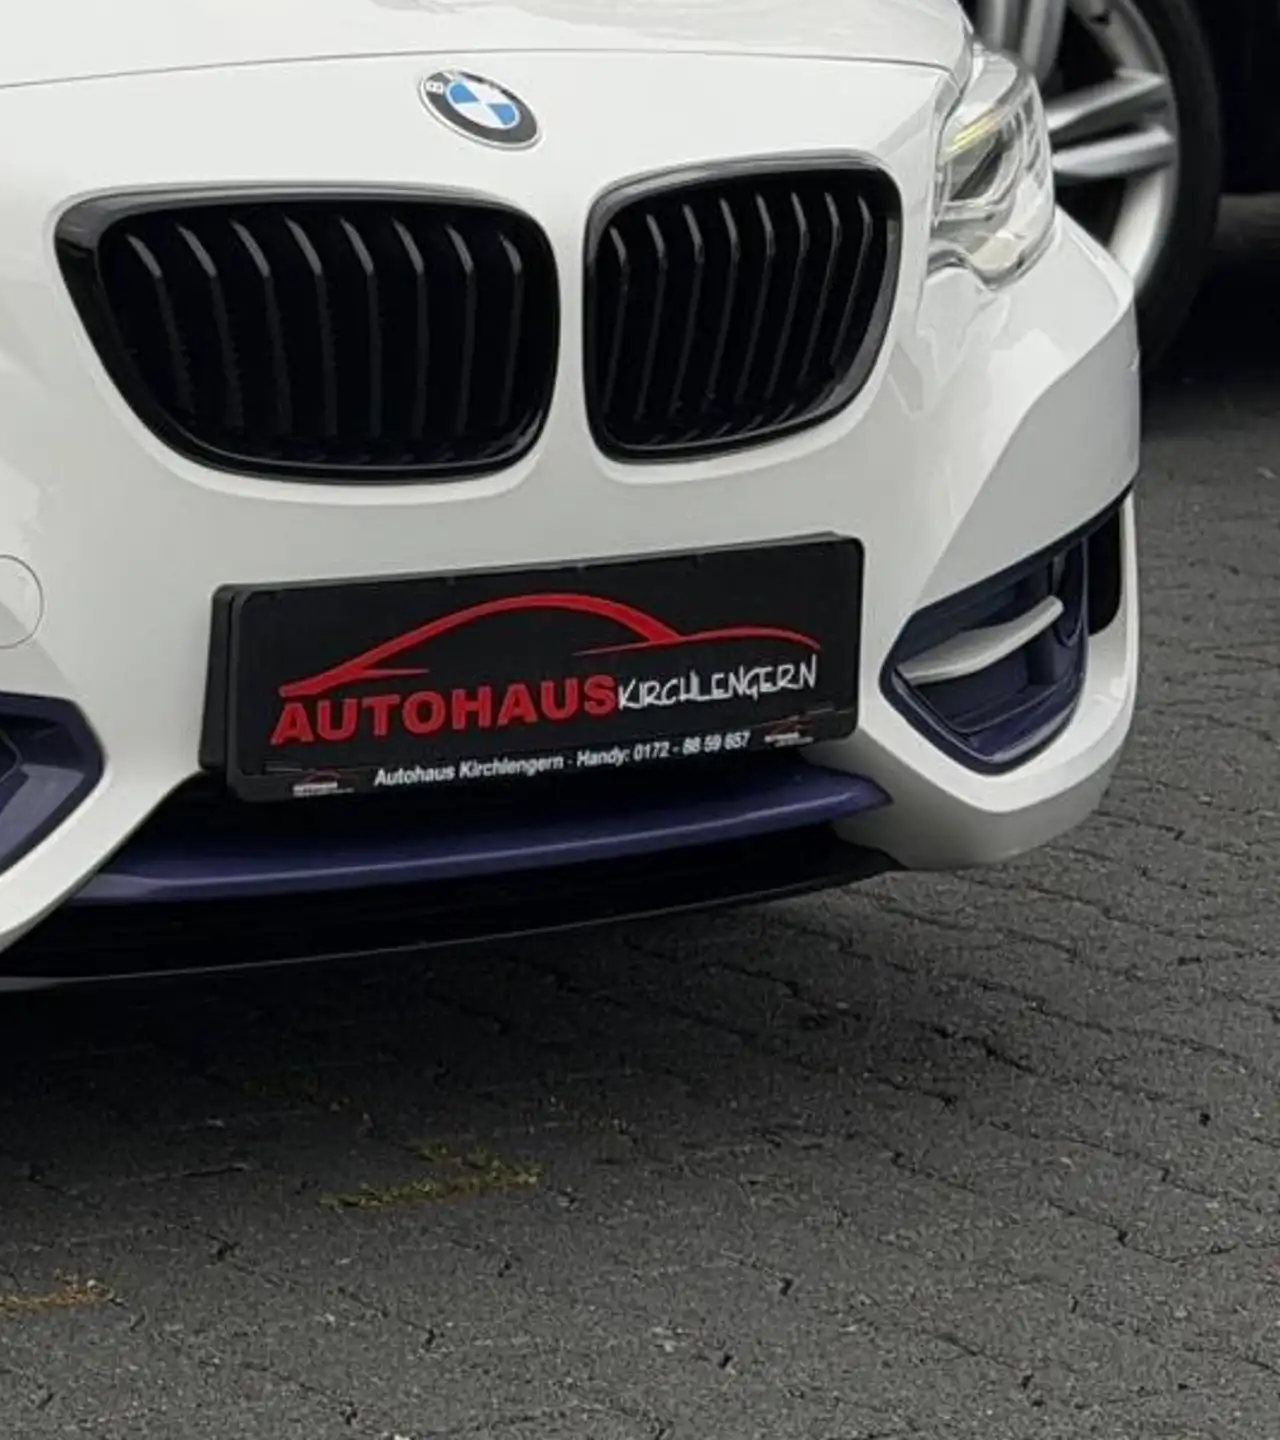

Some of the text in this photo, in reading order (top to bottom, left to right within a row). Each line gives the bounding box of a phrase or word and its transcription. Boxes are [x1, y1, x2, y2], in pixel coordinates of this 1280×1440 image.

[271, 653, 818, 745] AUTOHAUS KIRCHLENGERN
[373, 766, 456, 787] Autohaus
[458, 754, 565, 777] Kirchlengern
[576, 748, 631, 768] Handy:
[633, 740, 670, 761] 0172
[704, 734, 723, 754] 59
